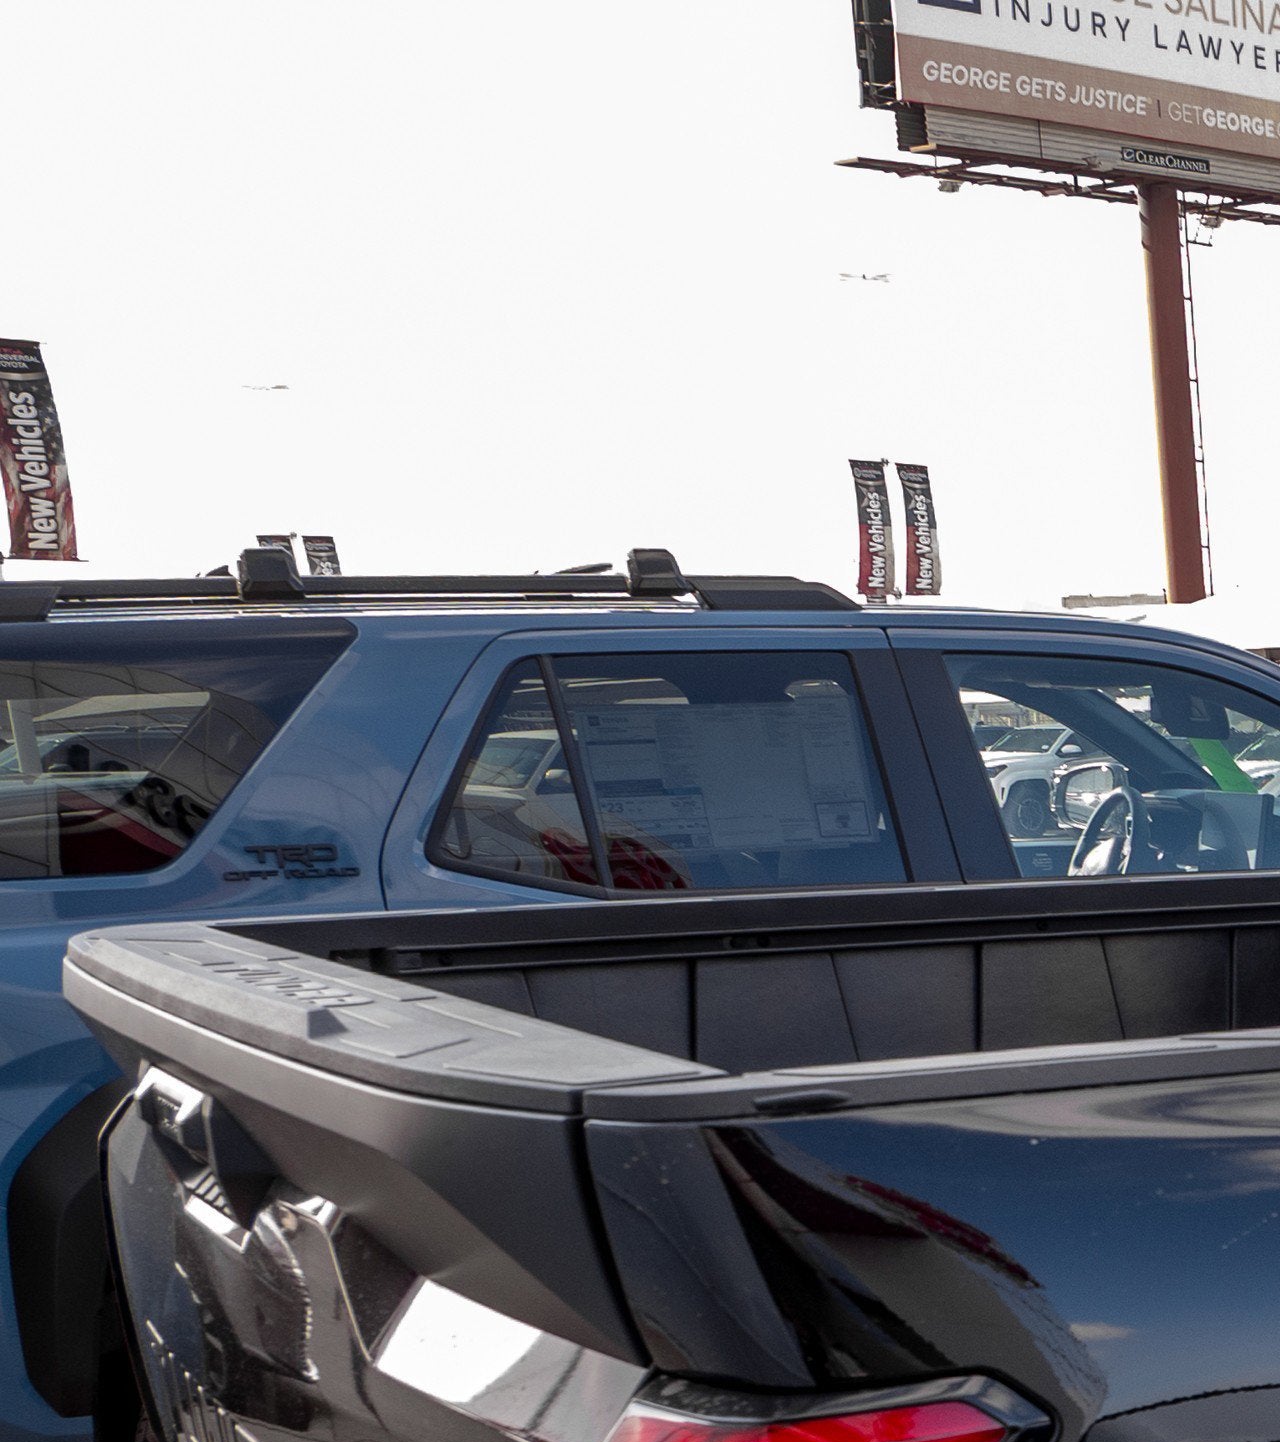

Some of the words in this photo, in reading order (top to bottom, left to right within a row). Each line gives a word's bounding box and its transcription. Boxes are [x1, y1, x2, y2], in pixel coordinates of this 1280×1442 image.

[992, 0, 1130, 42] INJURY
[922, 60, 1012, 93] GEORGE
[1015, 75, 1067, 101] GETS
[1069, 85, 1149, 116] JUSTICE
[6, 390, 52, 492] Vehicles
[27, 497, 59, 550] New
[866, 491, 885, 553] Vehicles
[913, 494, 932, 555] Vehicles
[867, 555, 885, 588] New
[915, 557, 933, 589] New
[223, 870, 279, 882] OFF
[283, 867, 360, 879] ROAD
[243, 843, 339, 869] TRD
